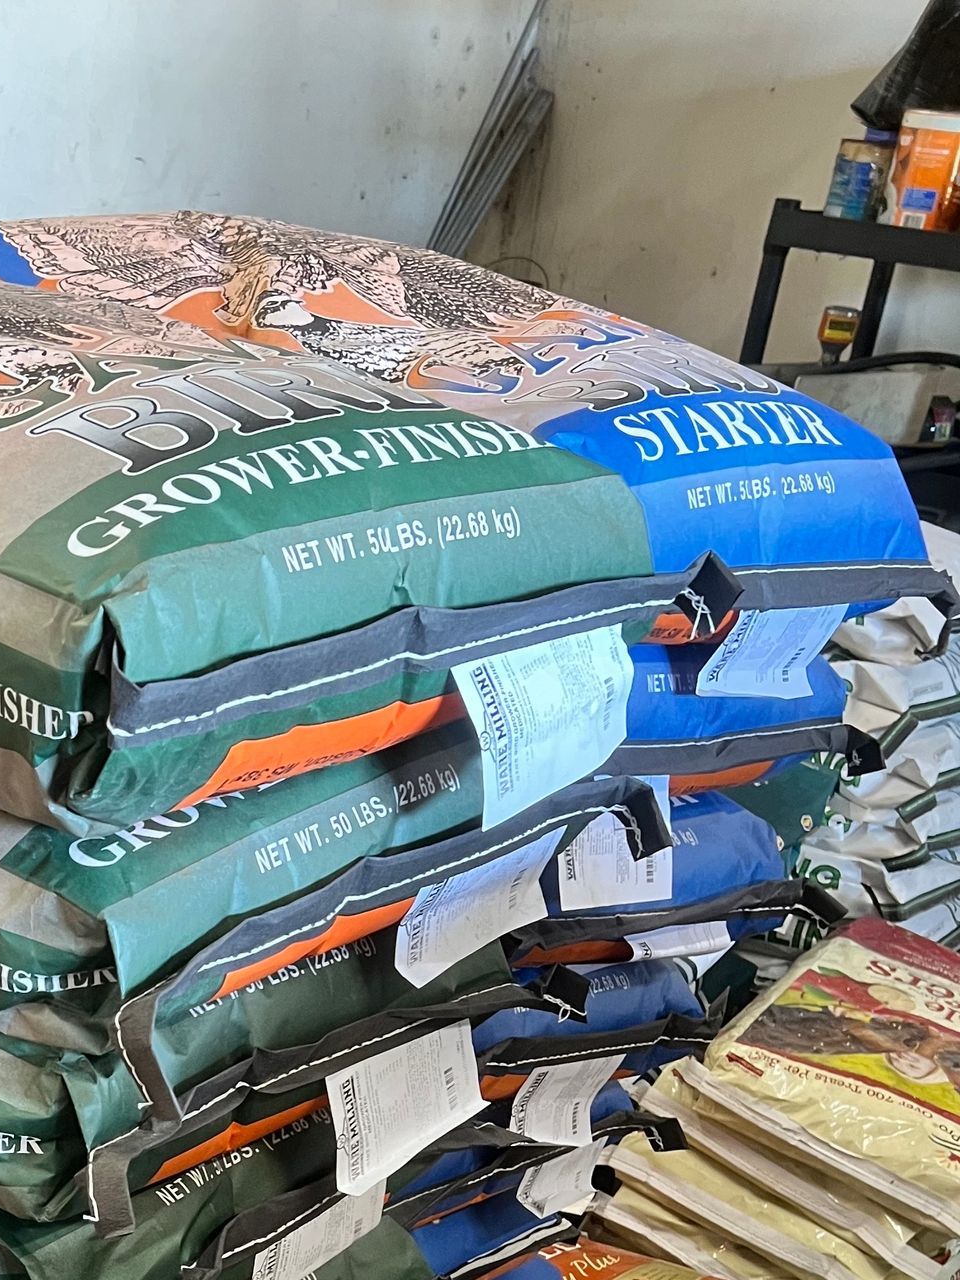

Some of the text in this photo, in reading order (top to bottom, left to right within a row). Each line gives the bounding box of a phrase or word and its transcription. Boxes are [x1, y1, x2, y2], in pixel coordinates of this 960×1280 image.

[613, 400, 842, 462] STARTER
[66, 420, 552, 558] GROWER-FINISH
[687, 485, 714, 509] NET
[715, 482, 738, 504] WT.
[780, 474, 814, 495] 22.68
[815, 471, 836, 494] kg)
[282, 539, 325, 575] NET
[326, 531, 365, 564] WT.
[438, 512, 488, 549] (22.68
[489, 505, 521, 543] kg)
[647, 674, 665, 692] NET
[472, 666, 511, 799] WARE MILLING
[254, 764, 461, 875] NET WT. 50 LBS. (22.68 kg)
[814, 1072, 862, 1096] Treats
[866, 1089, 893, 1104] 700
[311, 1105, 333, 1127] kg
[341, 1078, 360, 1139] MILLING
[900, 1099, 934, 1120] Over
[155, 1179, 191, 1207] NET
[571, 1253, 621, 1278] Plus
